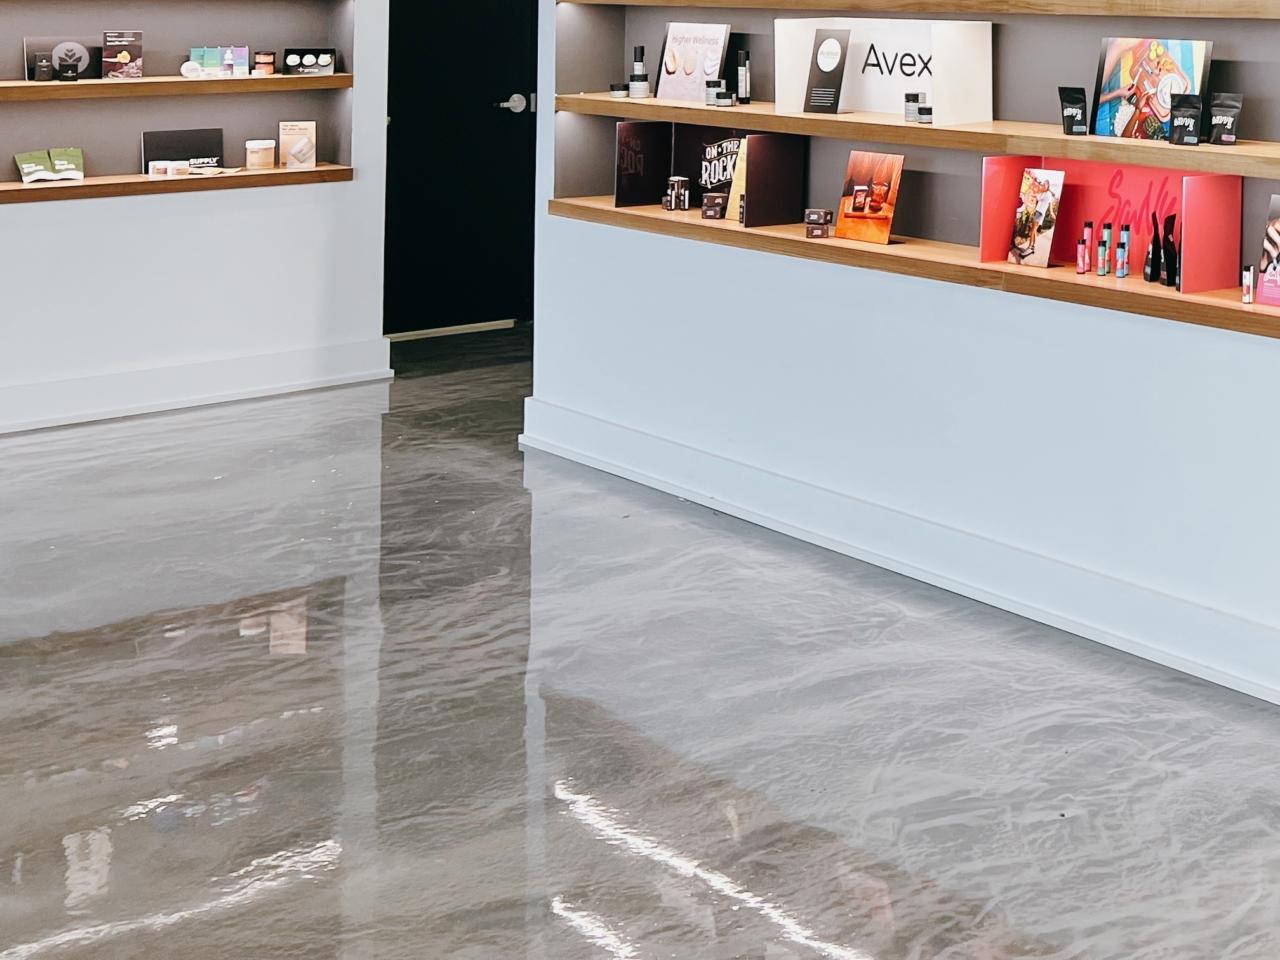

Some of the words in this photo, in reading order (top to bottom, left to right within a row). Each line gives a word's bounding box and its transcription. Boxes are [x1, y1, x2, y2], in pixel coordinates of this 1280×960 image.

[861, 43, 932, 78] Avex
[189, 156, 219, 164] SUPPLY
[705, 145, 718, 160] ON
[722, 141, 740, 154] THE
